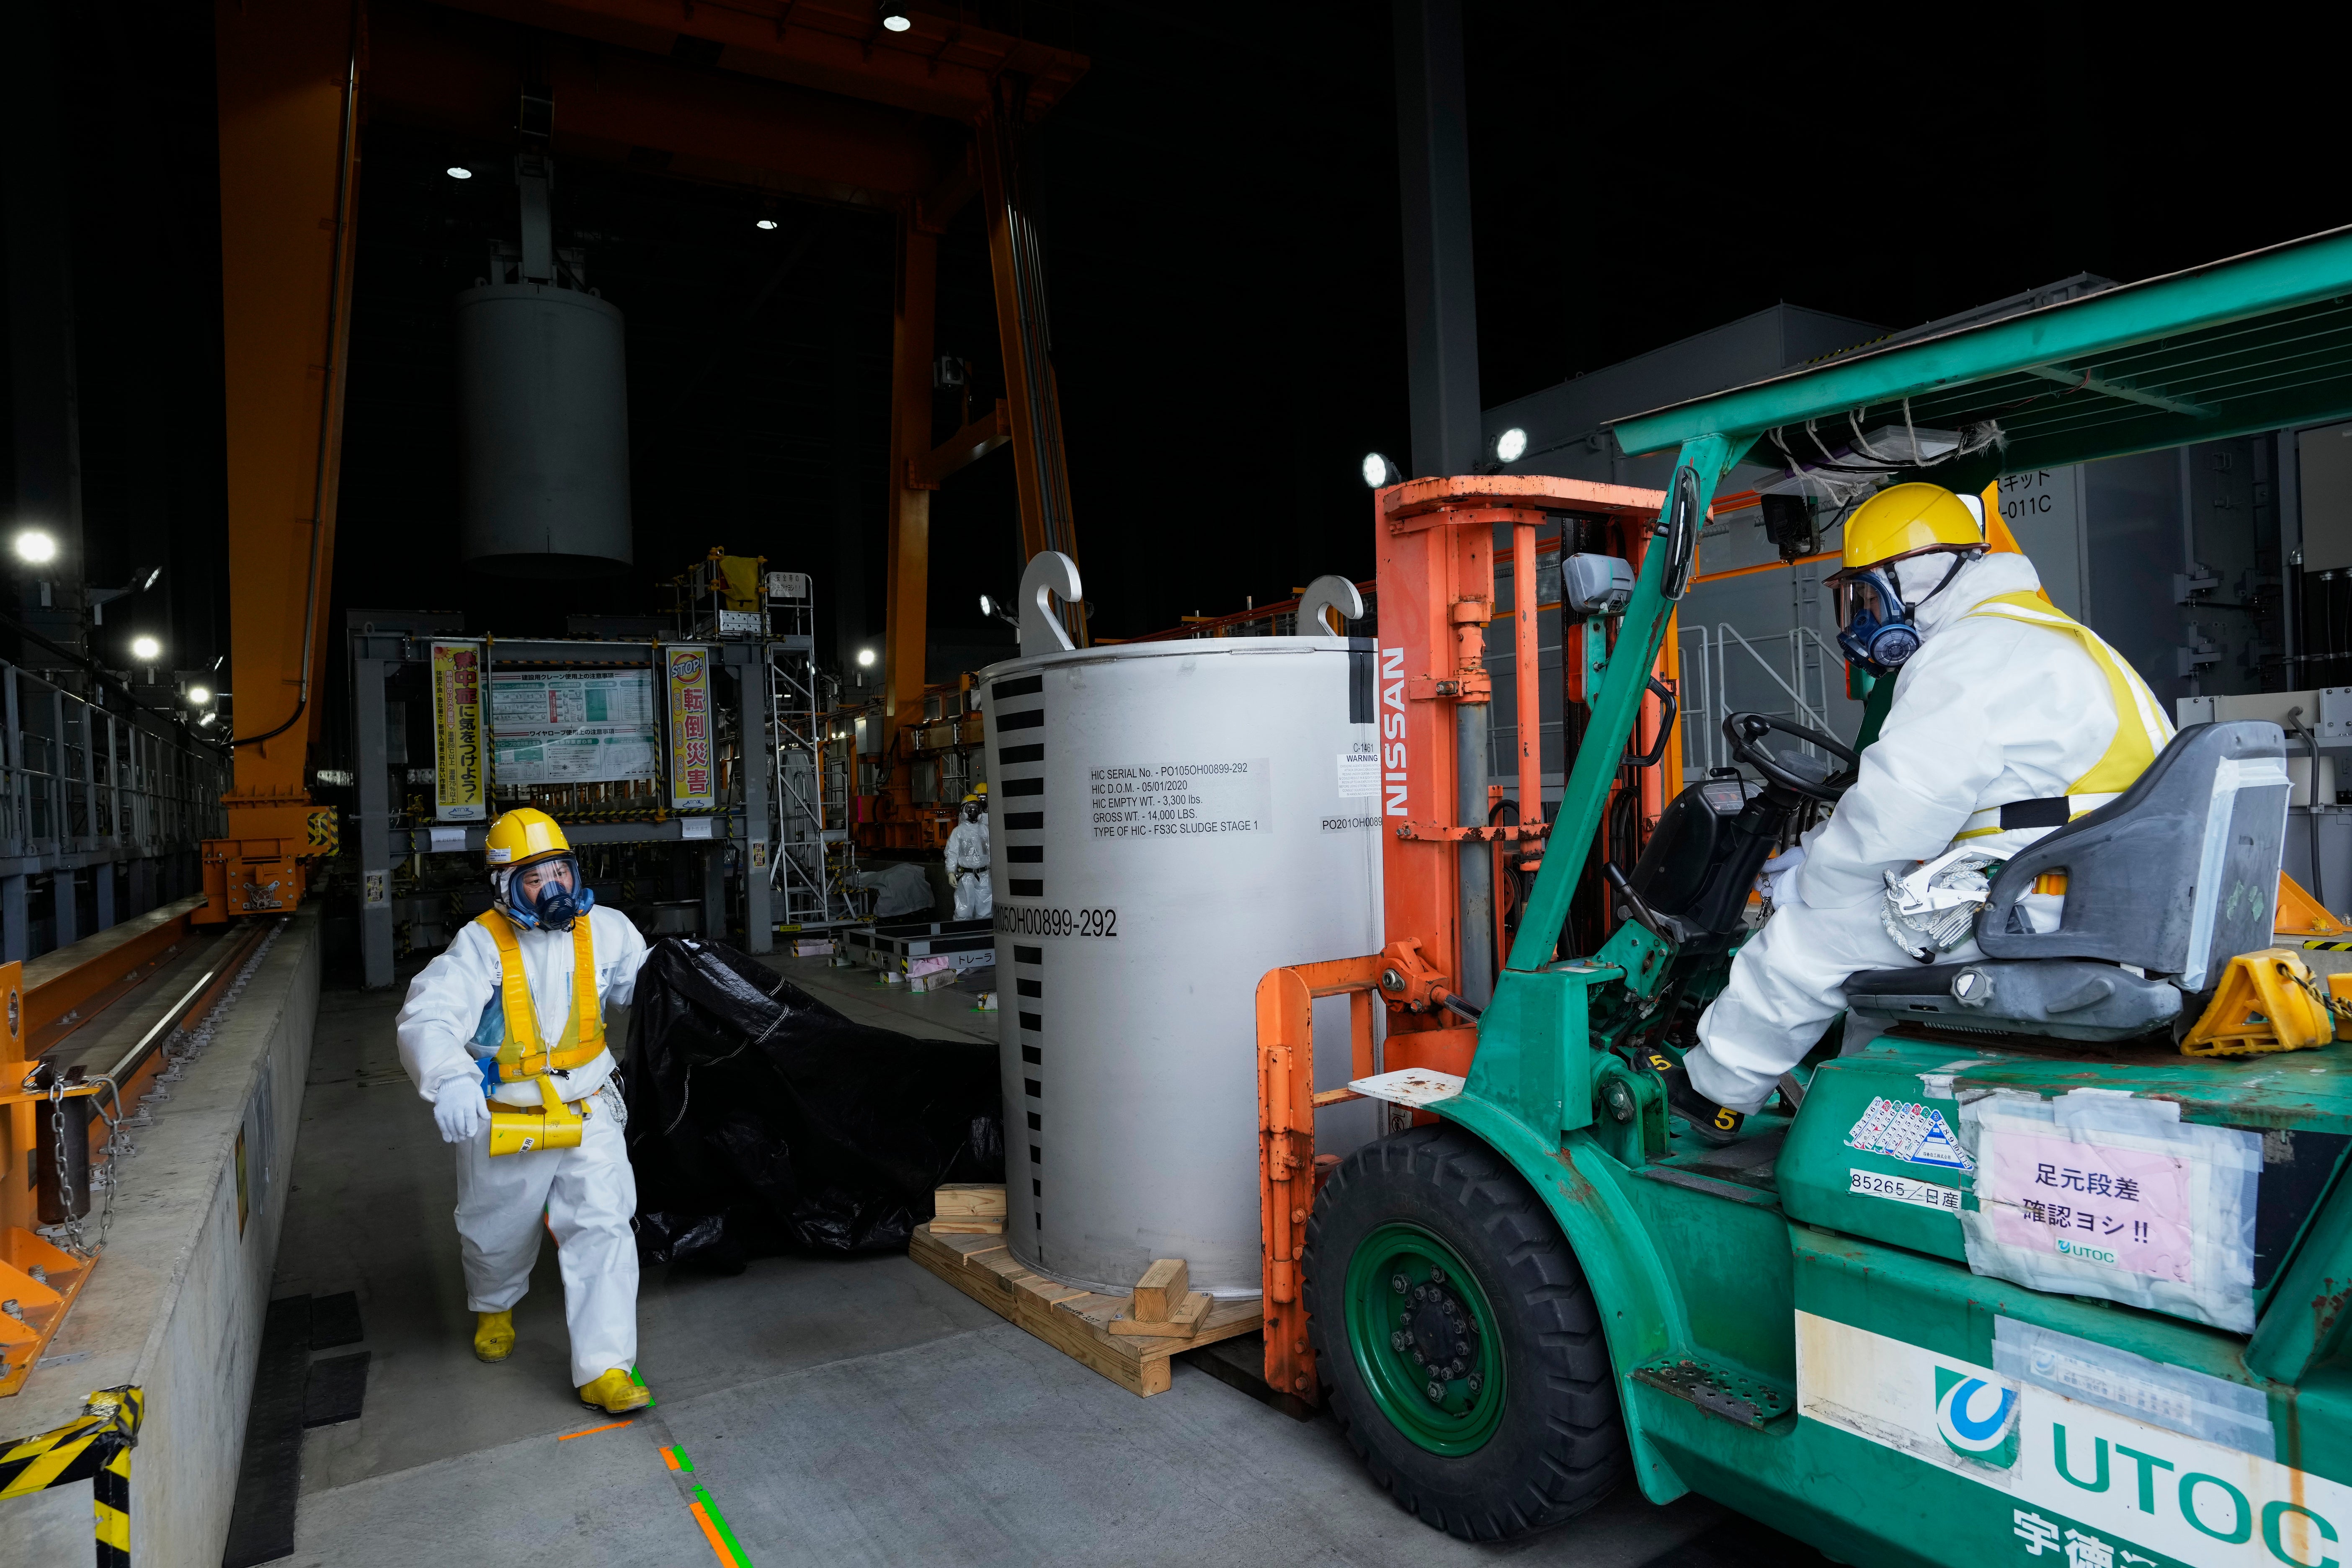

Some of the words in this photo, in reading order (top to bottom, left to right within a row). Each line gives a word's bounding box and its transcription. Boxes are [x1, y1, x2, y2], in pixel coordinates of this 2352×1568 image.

[1999, 495, 2051, 518] -011C
[671, 657, 702, 678] STOP!
[453, 651, 477, 803] 熱中症に気をつけよう！
[1382, 647, 1408, 816] NISSAN
[683, 688, 707, 792] 転倒災害
[1353, 743, 1373, 752] C-1461
[1091, 769, 1105, 780] HIC
[1107, 768, 1137, 779] SERIAL
[1140, 768, 1153, 778] No.
[1092, 784, 1105, 794] HIC
[1108, 783, 1134, 793] D.O.M.
[1142, 780, 1187, 792] 05/01/2020
[1093, 798, 1106, 808] HIC
[1109, 797, 1137, 807] EMPTY
[1140, 796, 1155, 806] WT.
[1163, 795, 1186, 806] 3,300
[1189, 794, 1203, 804] lbs.
[1093, 812, 1122, 823] GROSS
[1125, 811, 1140, 821] WT.
[1148, 810, 1175, 821] 14,000
[1178, 809, 1197, 819] LBS.
[1094, 827, 1114, 837] TYPE
[1117, 826, 1128, 836] OF
[1131, 825, 1146, 836] HIC
[1154, 824, 1177, 835] FS3C
[1180, 822, 1217, 833] SLUDGE
[1220, 820, 1251, 831] STAGE
[1254, 820, 1258, 830] 1
[959, 953, 992, 965] トレーラ
[1648, 1055, 1672, 1070] 5
[1715, 1107, 1737, 1130] 5
[2035, 1163, 2140, 1202] 足元段差
[2073, 1246, 2115, 1263] UTOC
[2053, 1422, 2340, 1568] UTOC
[2013, 1509, 2159, 1568] 宇徳
